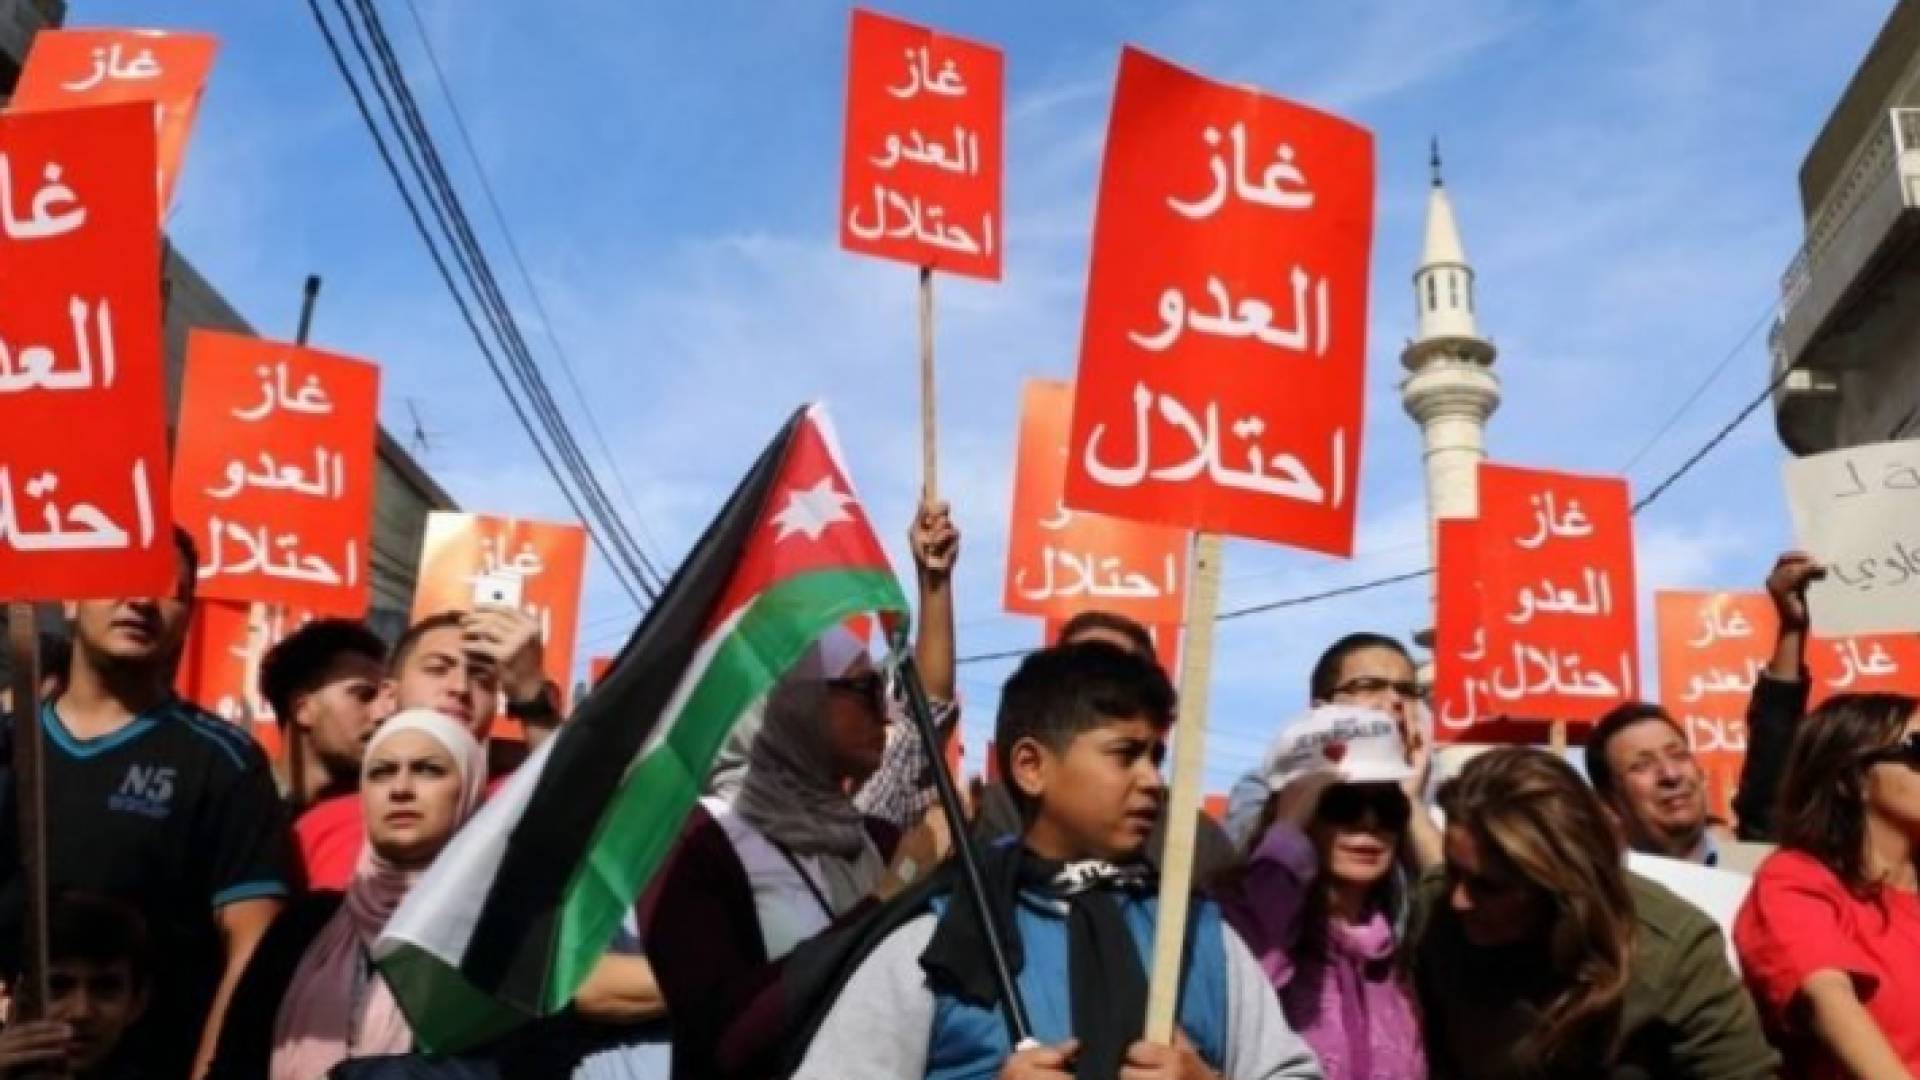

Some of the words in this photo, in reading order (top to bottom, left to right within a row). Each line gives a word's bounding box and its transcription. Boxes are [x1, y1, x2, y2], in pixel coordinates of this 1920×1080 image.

[63, 43, 162, 92] غاز
[889, 47, 967, 98] غاز
[871, 126, 979, 175] العدو
[1168, 122, 1314, 219] غاز
[0, 152, 87, 239] غا
[848, 184, 993, 258] احتلال
[1129, 265, 1330, 356] العدو
[232, 361, 333, 421] غاز
[206, 446, 345, 498] العدو
[1083, 381, 1346, 508] احتلال
[1516, 491, 1594, 548] غاز
[196, 515, 358, 586] احتلال
[1015, 546, 1176, 600] احتلال
[1506, 567, 1612, 624] العدو
[1685, 594, 1754, 648] غاز
[1492, 641, 1633, 700] احتلال
[1826, 638, 1899, 688] غاز
[119, 763, 178, 801] N5
